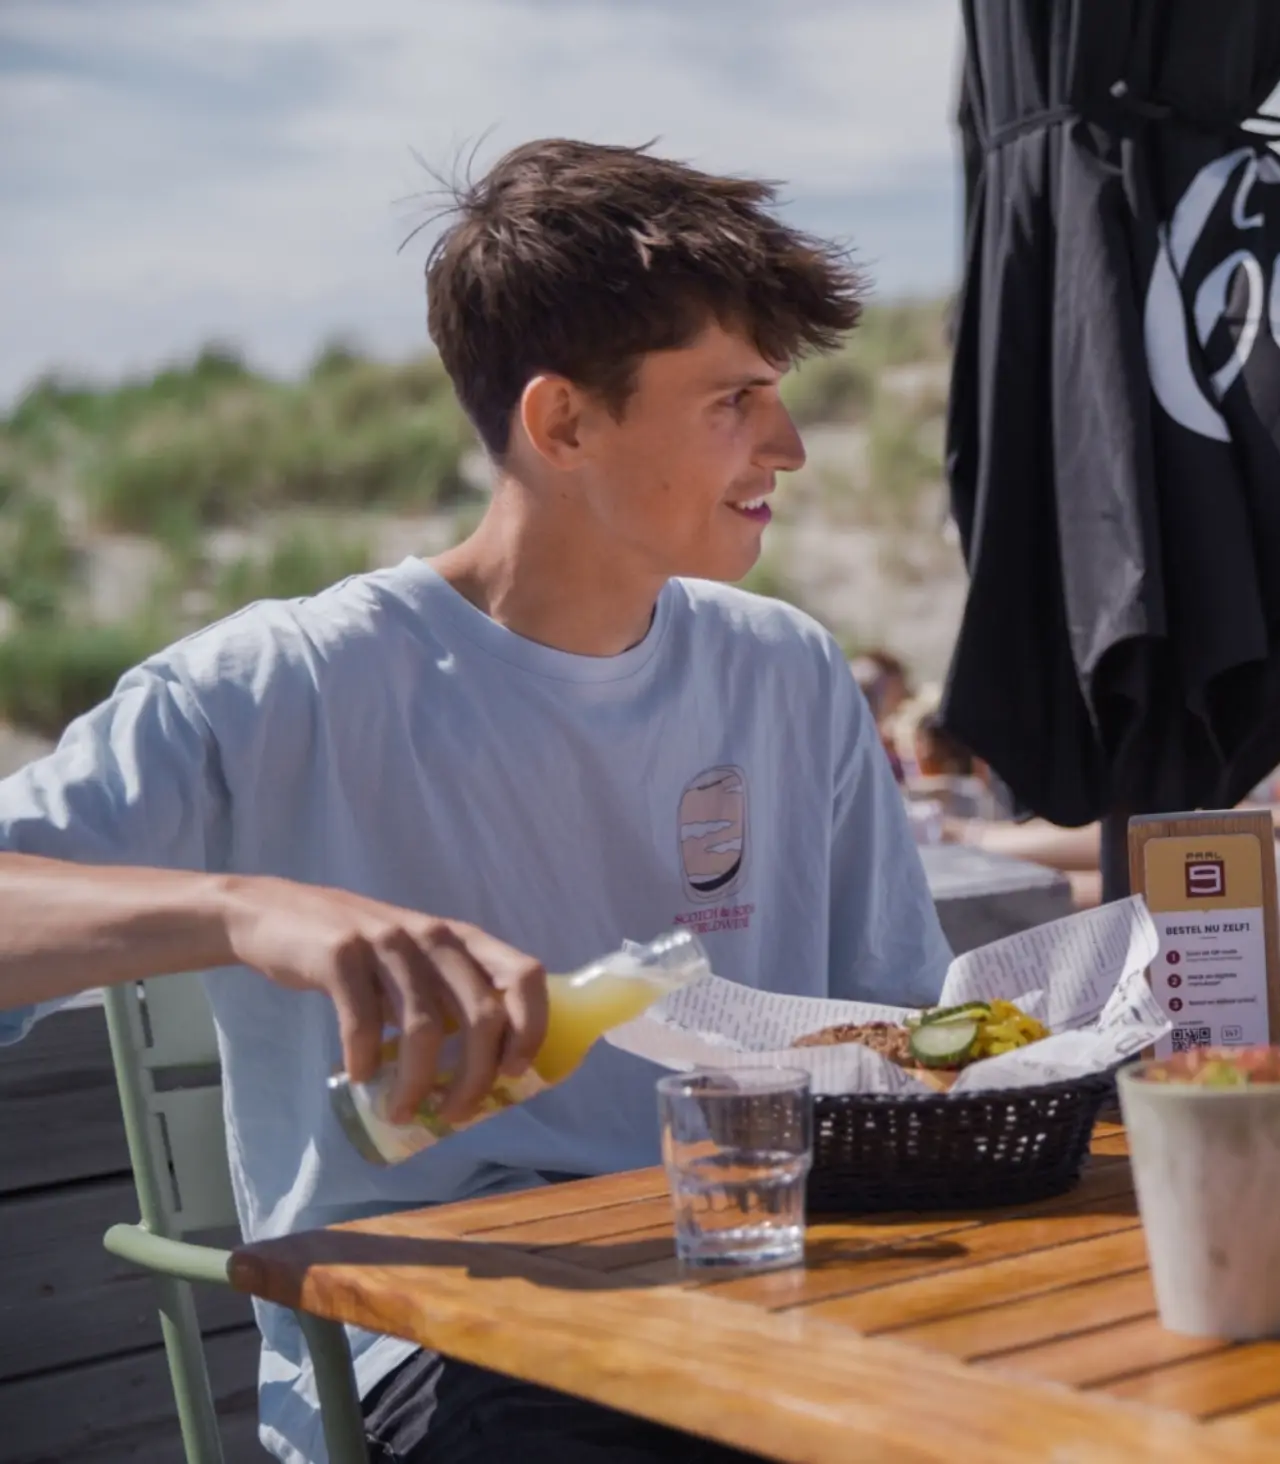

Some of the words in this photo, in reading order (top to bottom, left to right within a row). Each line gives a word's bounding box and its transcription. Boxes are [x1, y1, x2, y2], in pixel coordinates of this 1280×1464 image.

[1189, 864, 1222, 895] 9
[1166, 925, 1203, 936] BESTEL
[1204, 924, 1220, 934] NU
